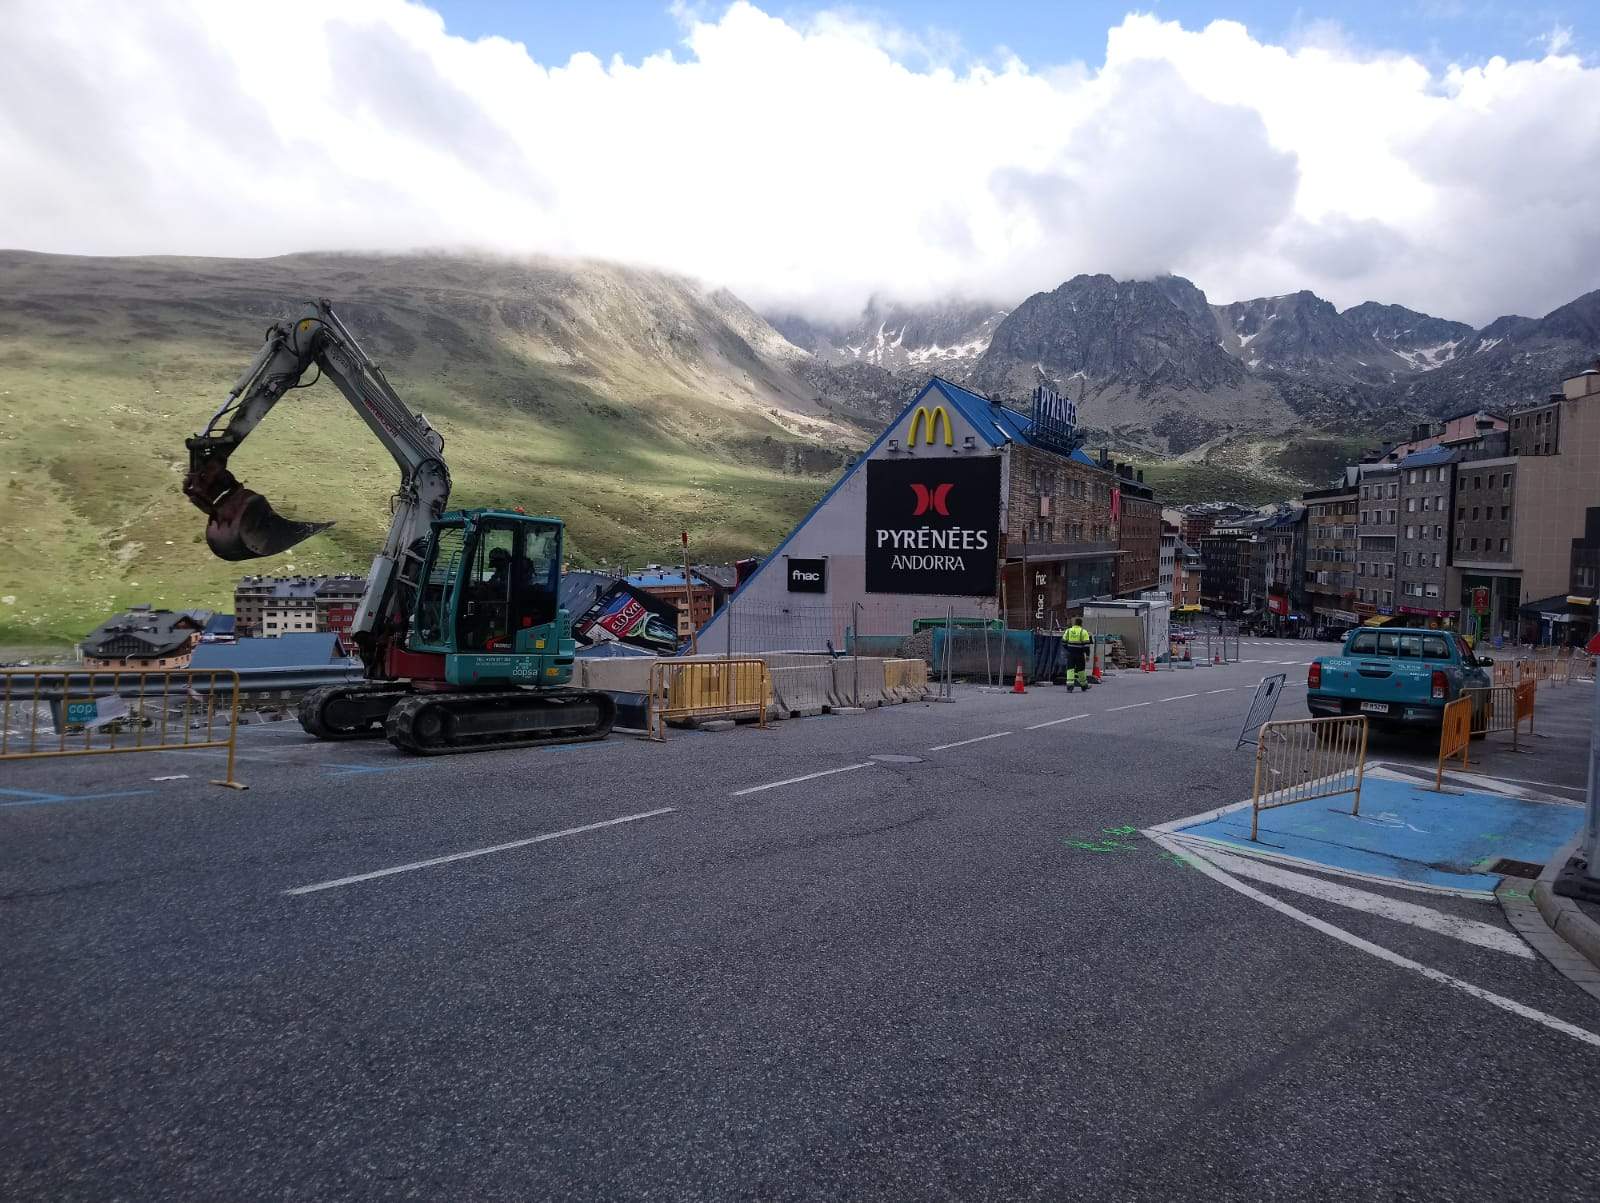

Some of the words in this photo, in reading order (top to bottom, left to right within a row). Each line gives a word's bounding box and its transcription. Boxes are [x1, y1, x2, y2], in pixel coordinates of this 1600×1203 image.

[891, 554, 966, 571] ANDORRA
[792, 569, 820, 581] fnac
[1035, 570, 1047, 586] fnac
[1035, 594, 1044, 619] fnac
